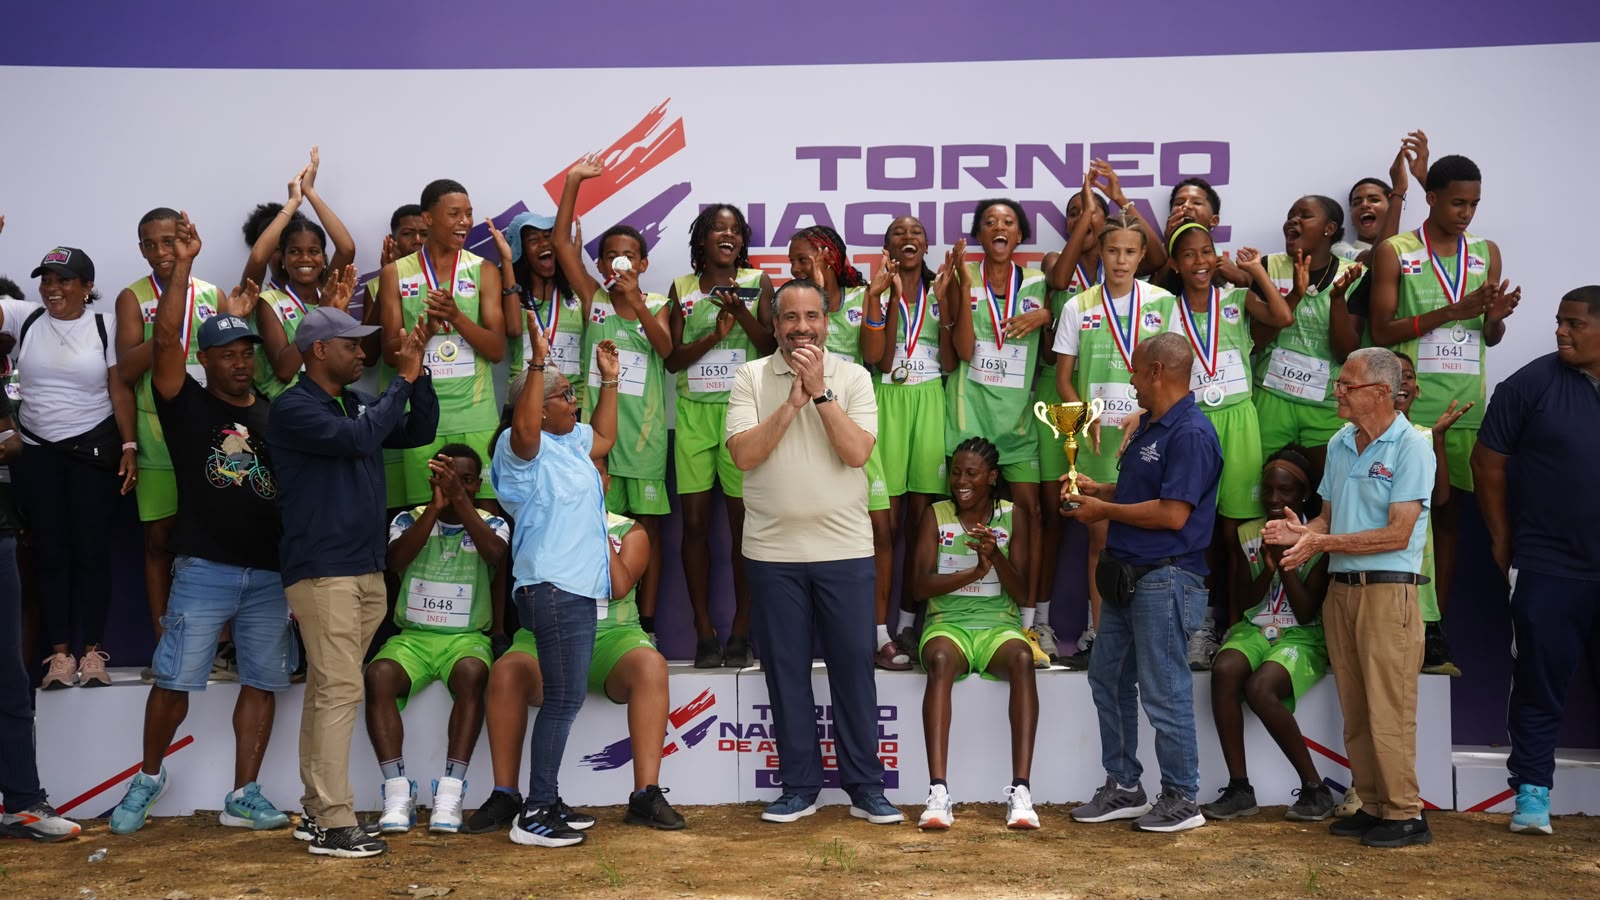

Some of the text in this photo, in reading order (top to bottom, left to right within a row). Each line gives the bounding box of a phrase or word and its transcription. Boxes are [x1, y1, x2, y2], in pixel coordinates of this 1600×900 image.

[795, 140, 1230, 191] TORNEO
[1435, 345, 1463, 357] 1641
[700, 365, 728, 377] 1630
[900, 359, 925, 371] 1618
[1442, 362, 1462, 370] INEFI
[433, 368, 454, 376] INEFI
[1197, 369, 1225, 385] 1627
[1282, 366, 1312, 382] 1620
[984, 374, 1003, 383] INEFI
[1283, 383, 1305, 395] INEFI
[1104, 400, 1133, 412] 1626
[960, 585, 980, 593] INEFI
[422, 597, 453, 611] 1648
[426, 614, 448, 624] INEFI
[718, 739, 752, 752] DE
